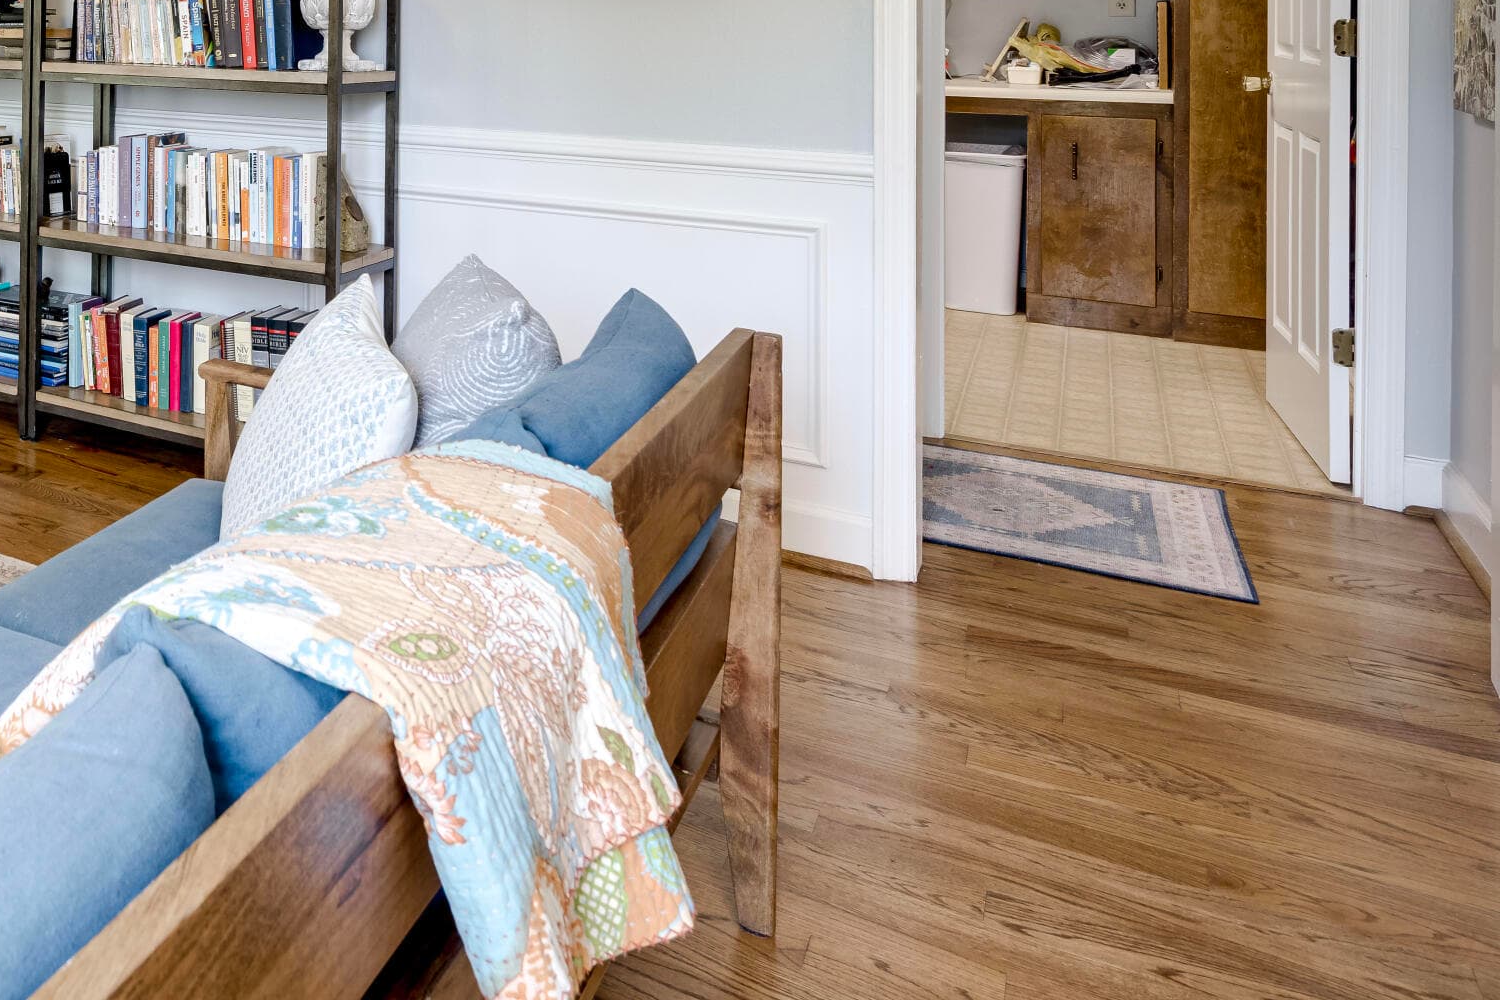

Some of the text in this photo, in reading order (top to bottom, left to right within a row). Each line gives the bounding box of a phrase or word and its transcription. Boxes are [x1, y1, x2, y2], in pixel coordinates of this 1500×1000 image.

[192, 1, 200, 26] Spain
[181, 14, 189, 39] SPAIN
[236, 346, 249, 354] NIV
